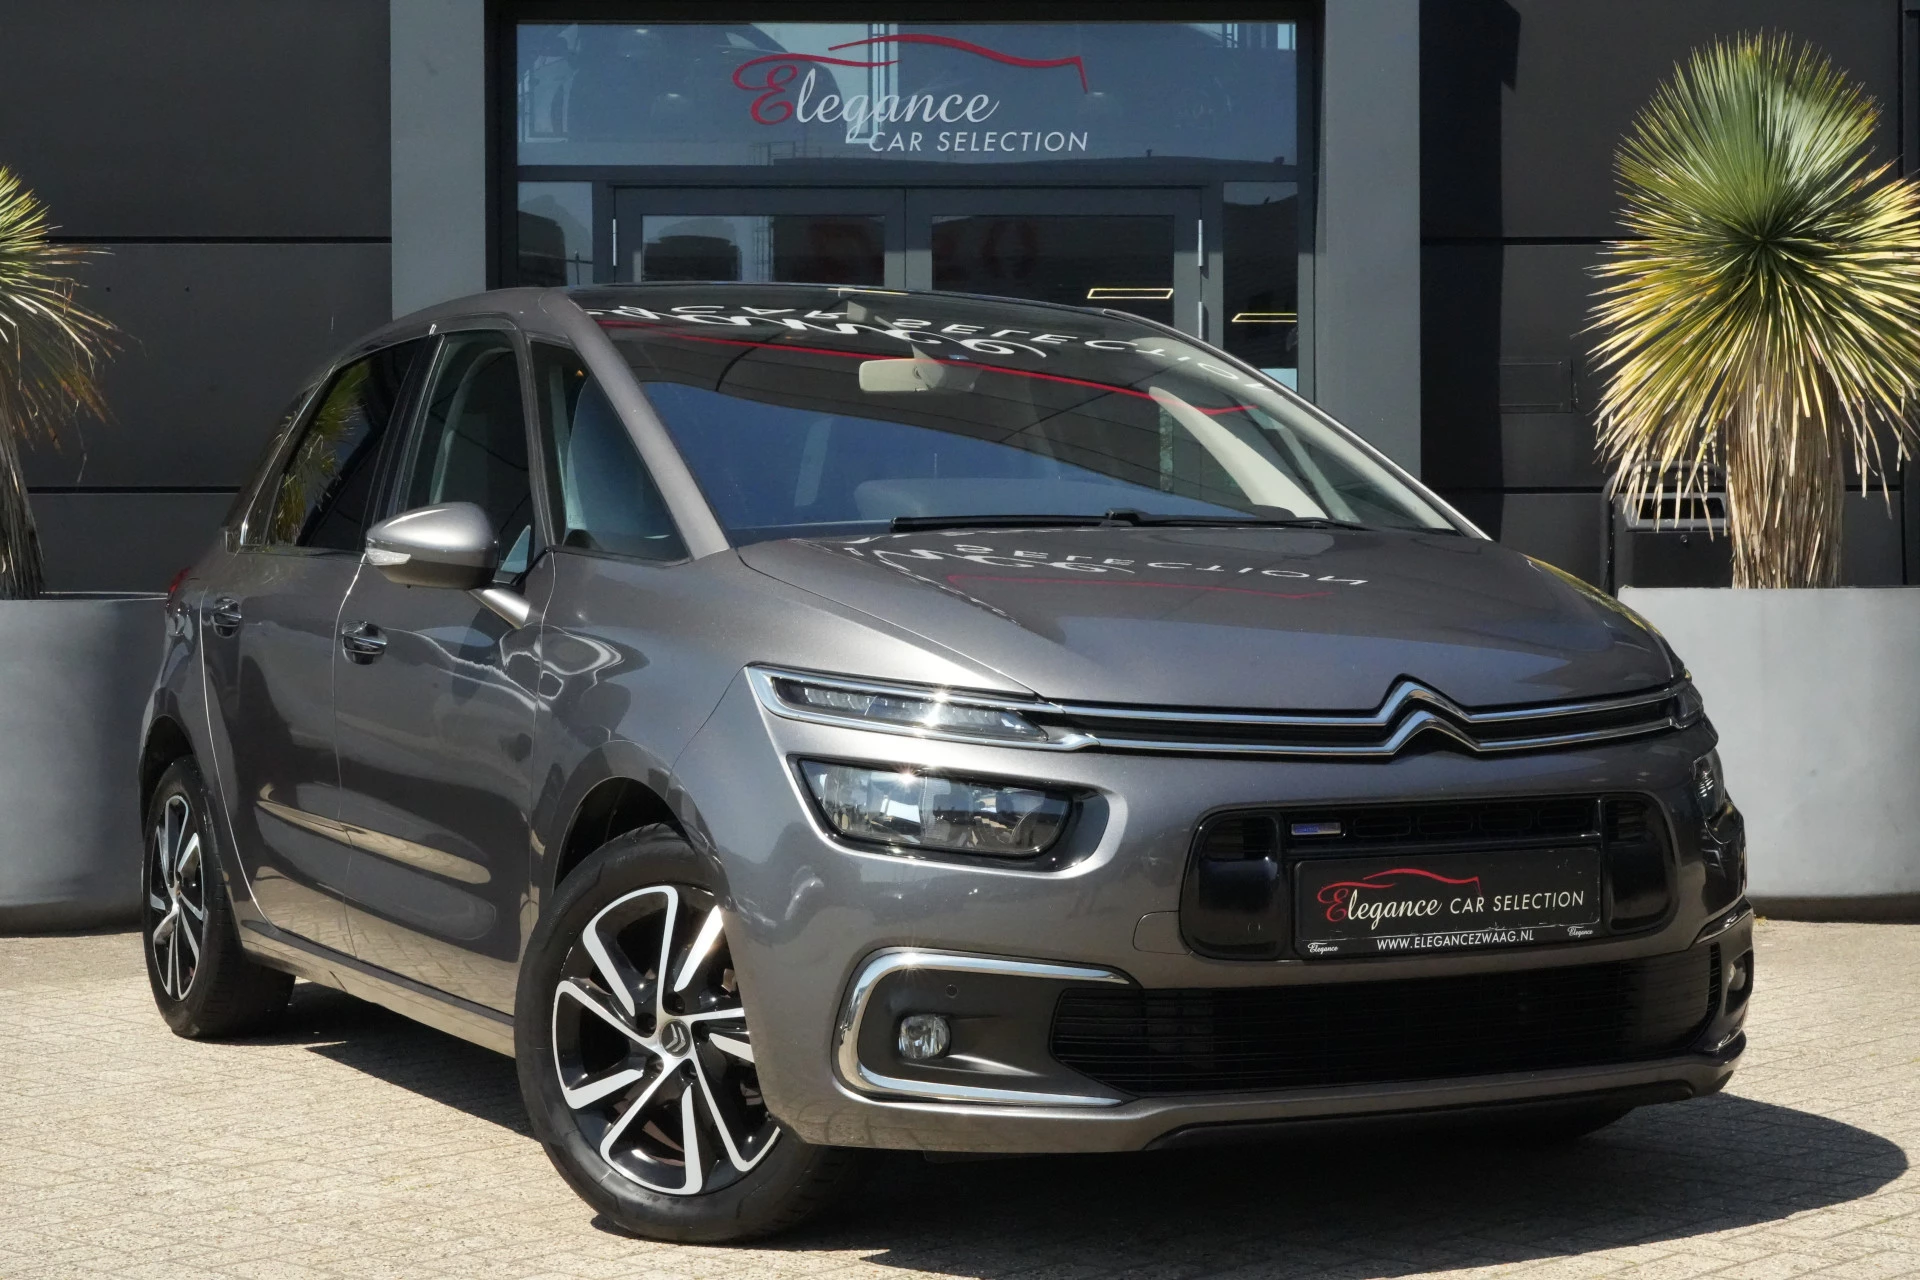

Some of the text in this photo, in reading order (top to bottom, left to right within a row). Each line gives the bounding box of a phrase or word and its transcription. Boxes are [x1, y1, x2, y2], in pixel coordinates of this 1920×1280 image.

[732, 53, 999, 143] Elegance
[869, 131, 1088, 152] CAR SELECTION
[1317, 881, 1584, 930] Elegance CAR SELECTION
[1377, 931, 1534, 950] WWW.ELEGANCEZWAAG.NL
[1567, 926, 1593, 937] Elegance
[1307, 942, 1339, 954] Elegance
